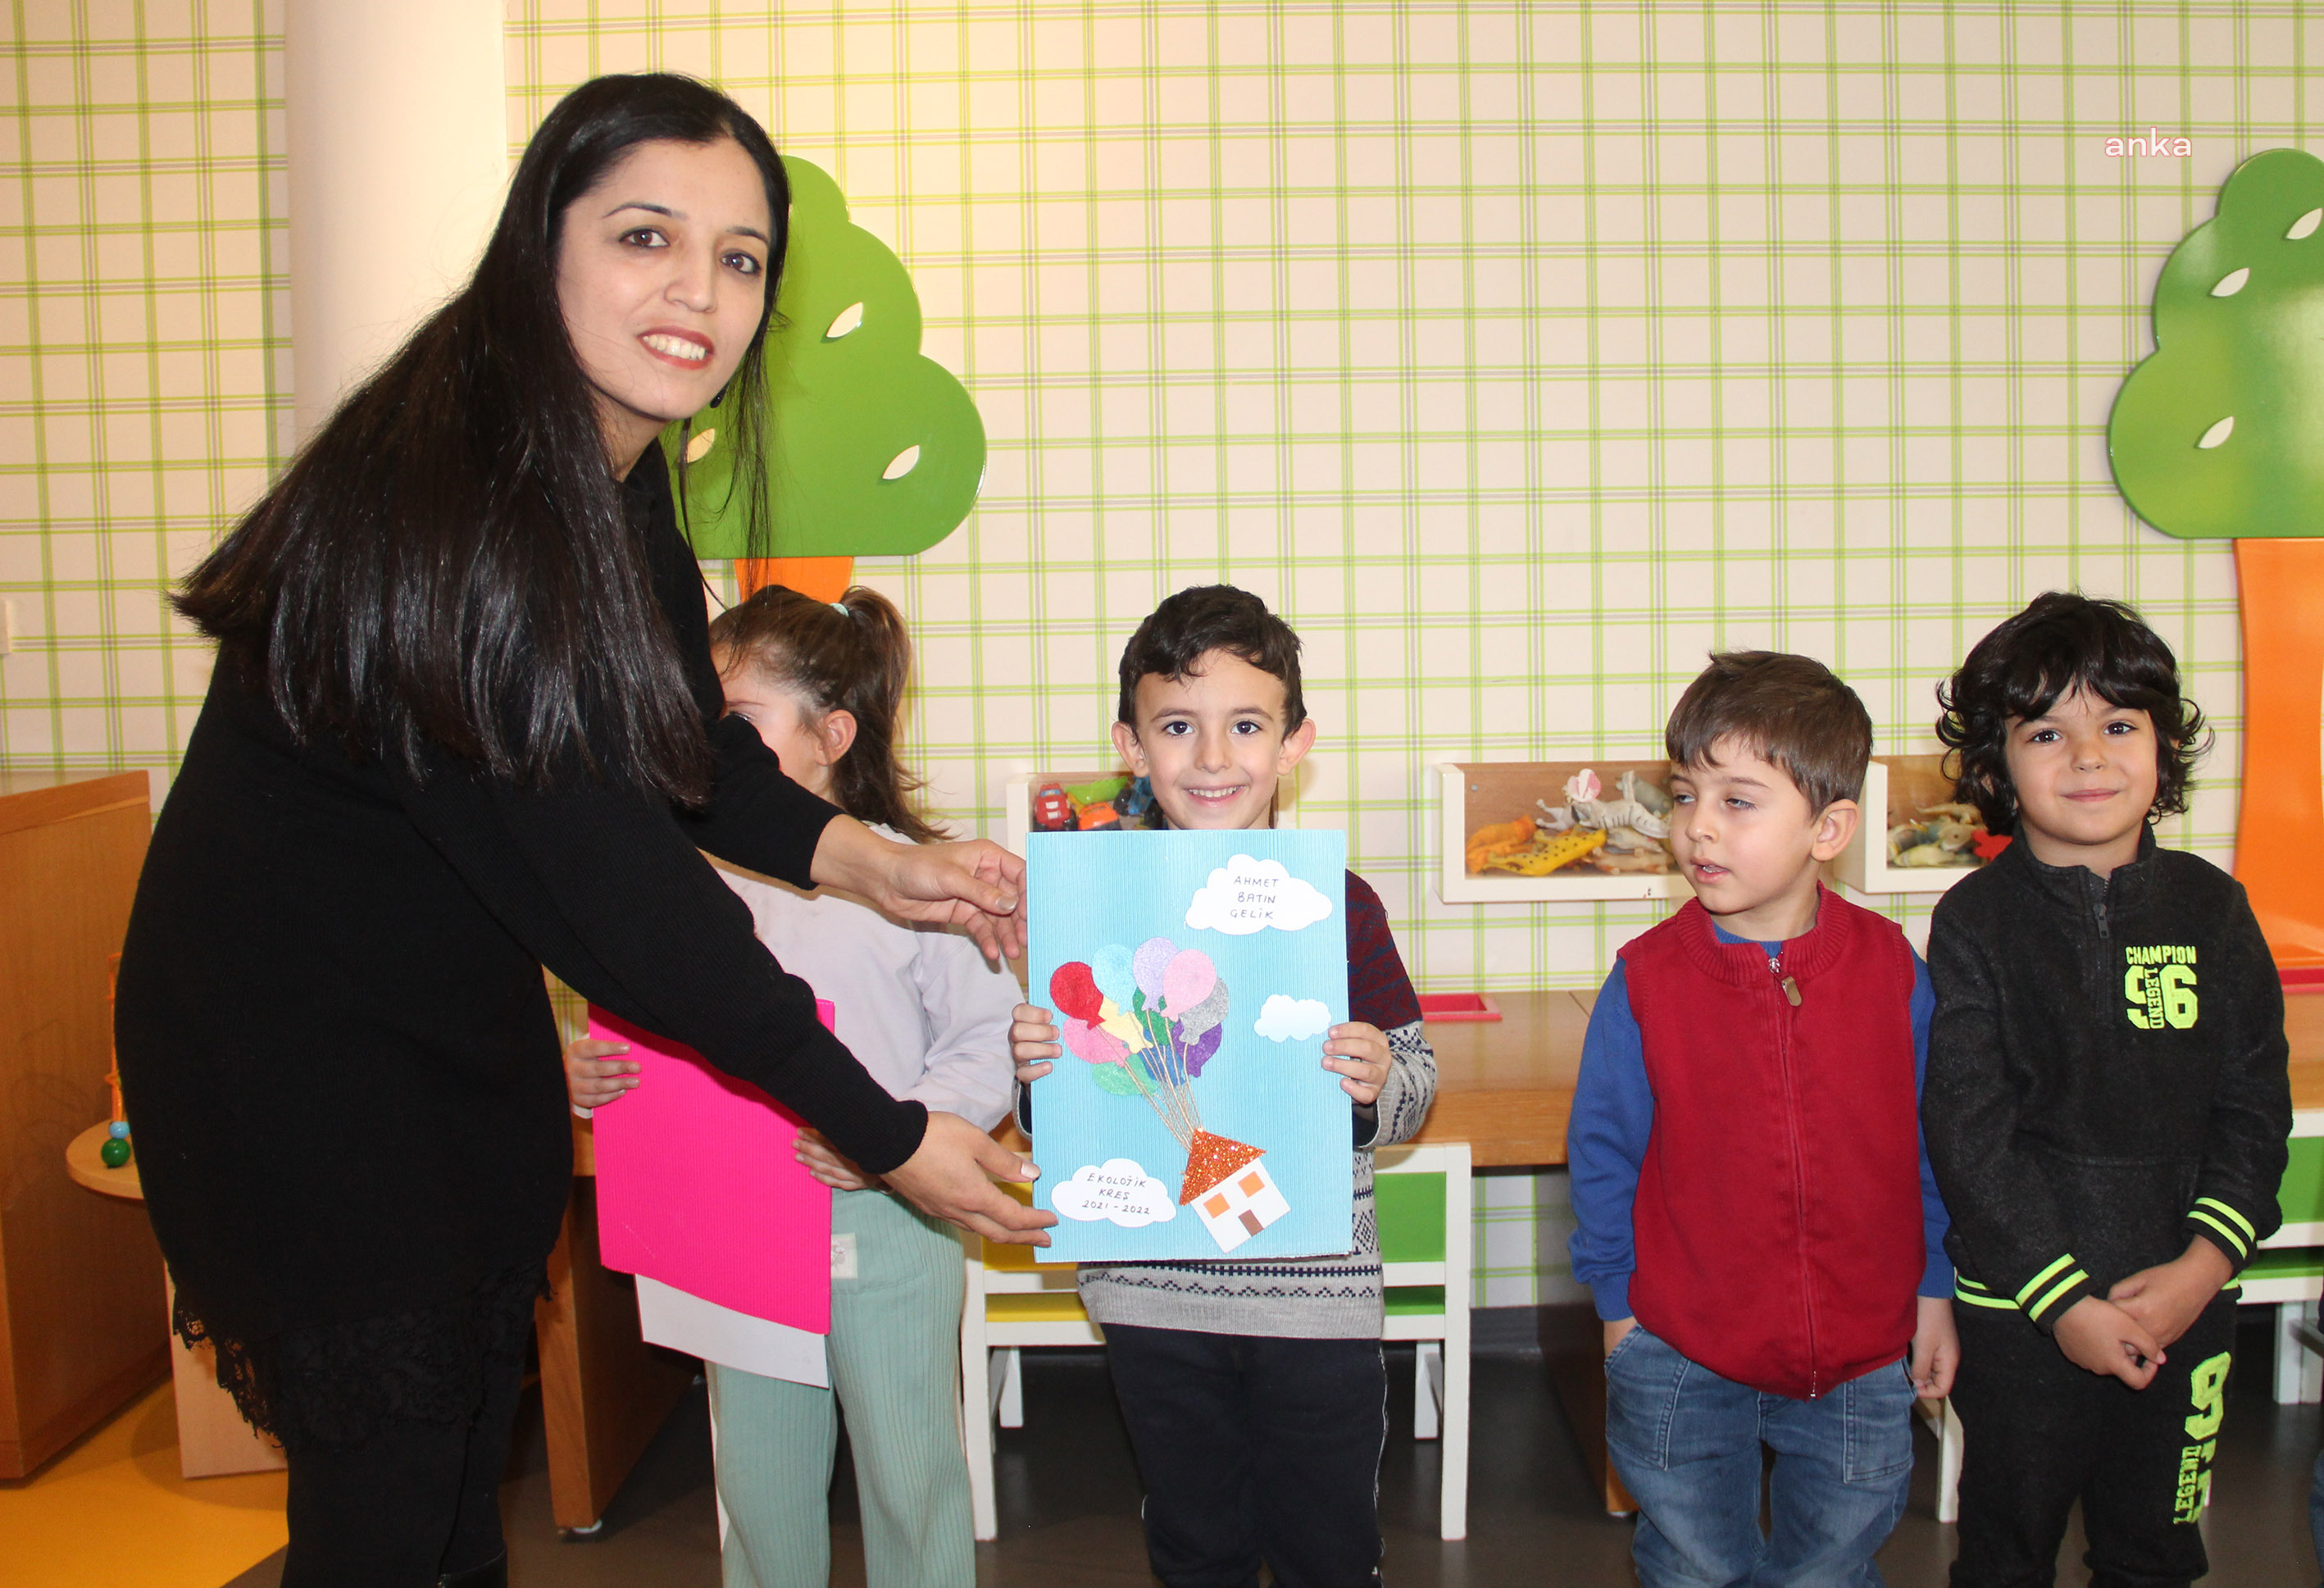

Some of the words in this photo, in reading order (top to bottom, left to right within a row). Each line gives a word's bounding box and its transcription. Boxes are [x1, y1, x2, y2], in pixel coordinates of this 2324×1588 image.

[1233, 876, 1280, 888] AHMET
[1237, 891, 1276, 903] BATIN
[2126, 945, 2197, 965] CHAMPION
[2144, 967, 2165, 1029] LEGEND
[1098, 1189, 1130, 1201] KREŞ
[2173, 1445, 2202, 1524] LEGEND
